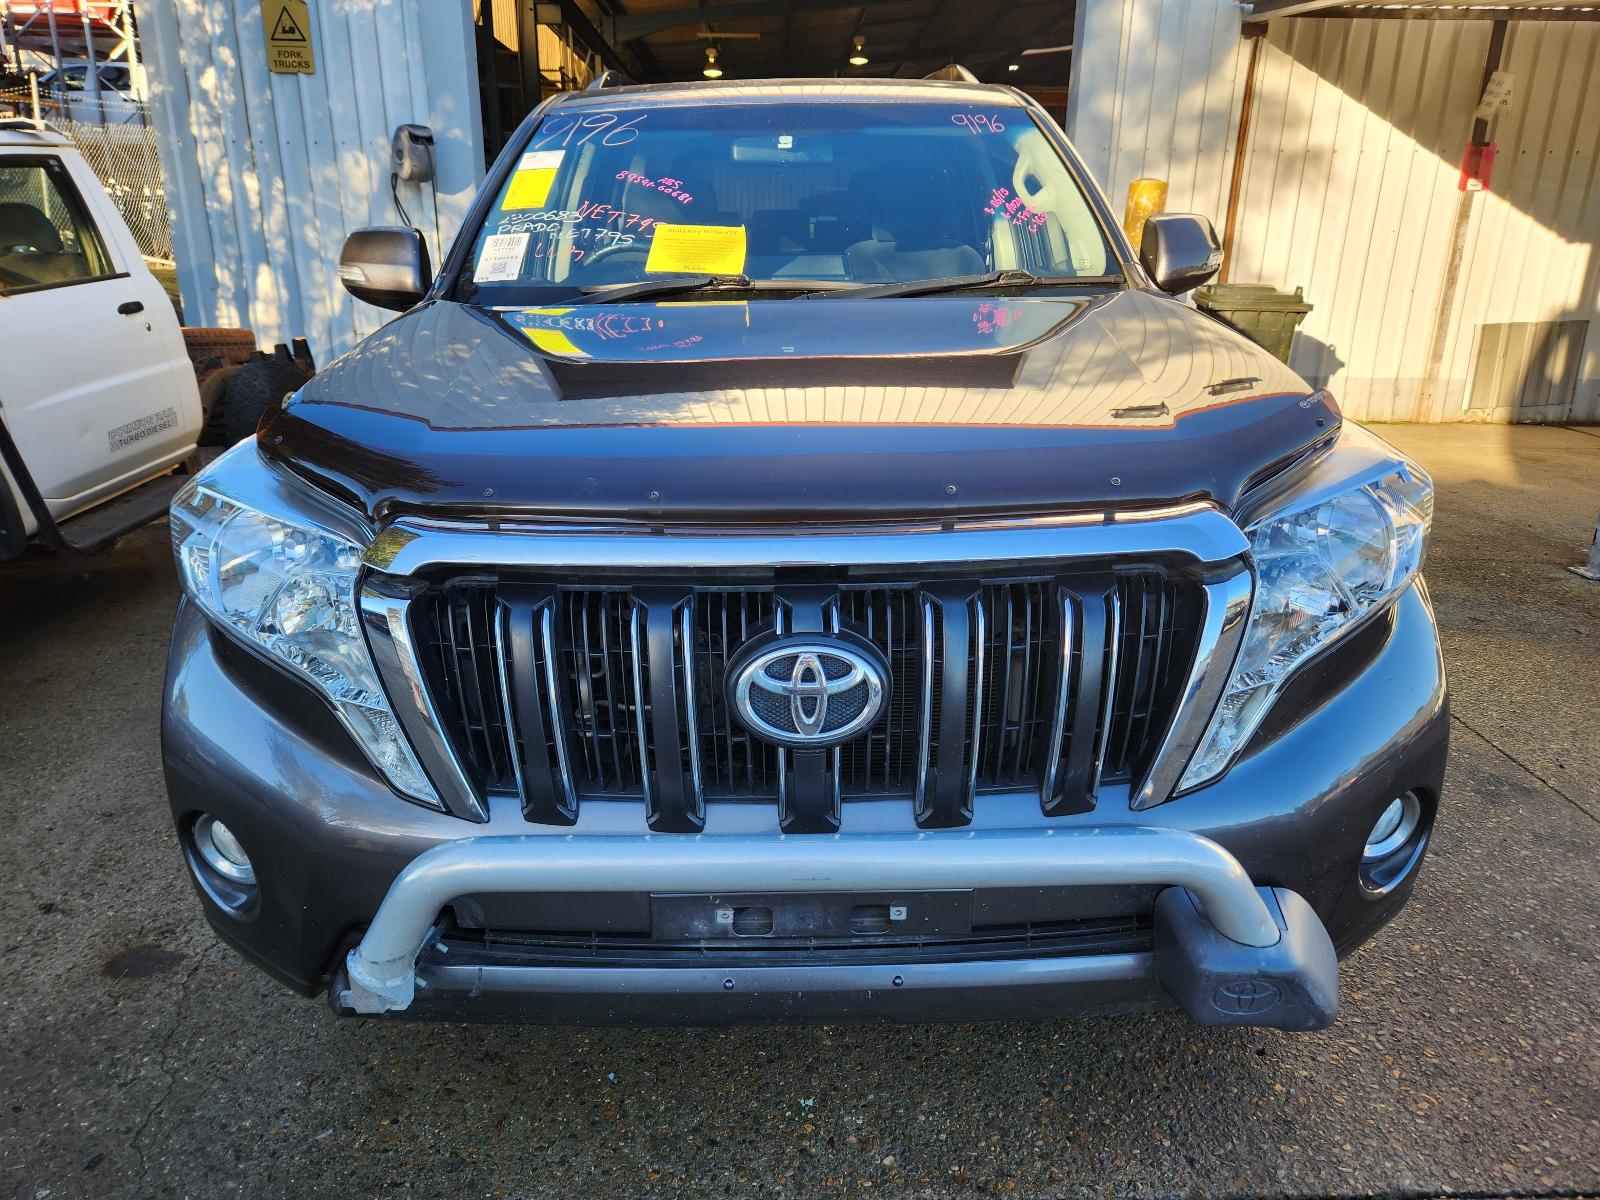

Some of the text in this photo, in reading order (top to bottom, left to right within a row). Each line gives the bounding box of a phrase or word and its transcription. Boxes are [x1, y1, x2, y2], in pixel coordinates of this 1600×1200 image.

[277, 50, 303, 59] FORK
[272, 60, 311, 69] TRUCKS
[534, 113, 648, 149] 9196
[951, 113, 1005, 135] 9196
